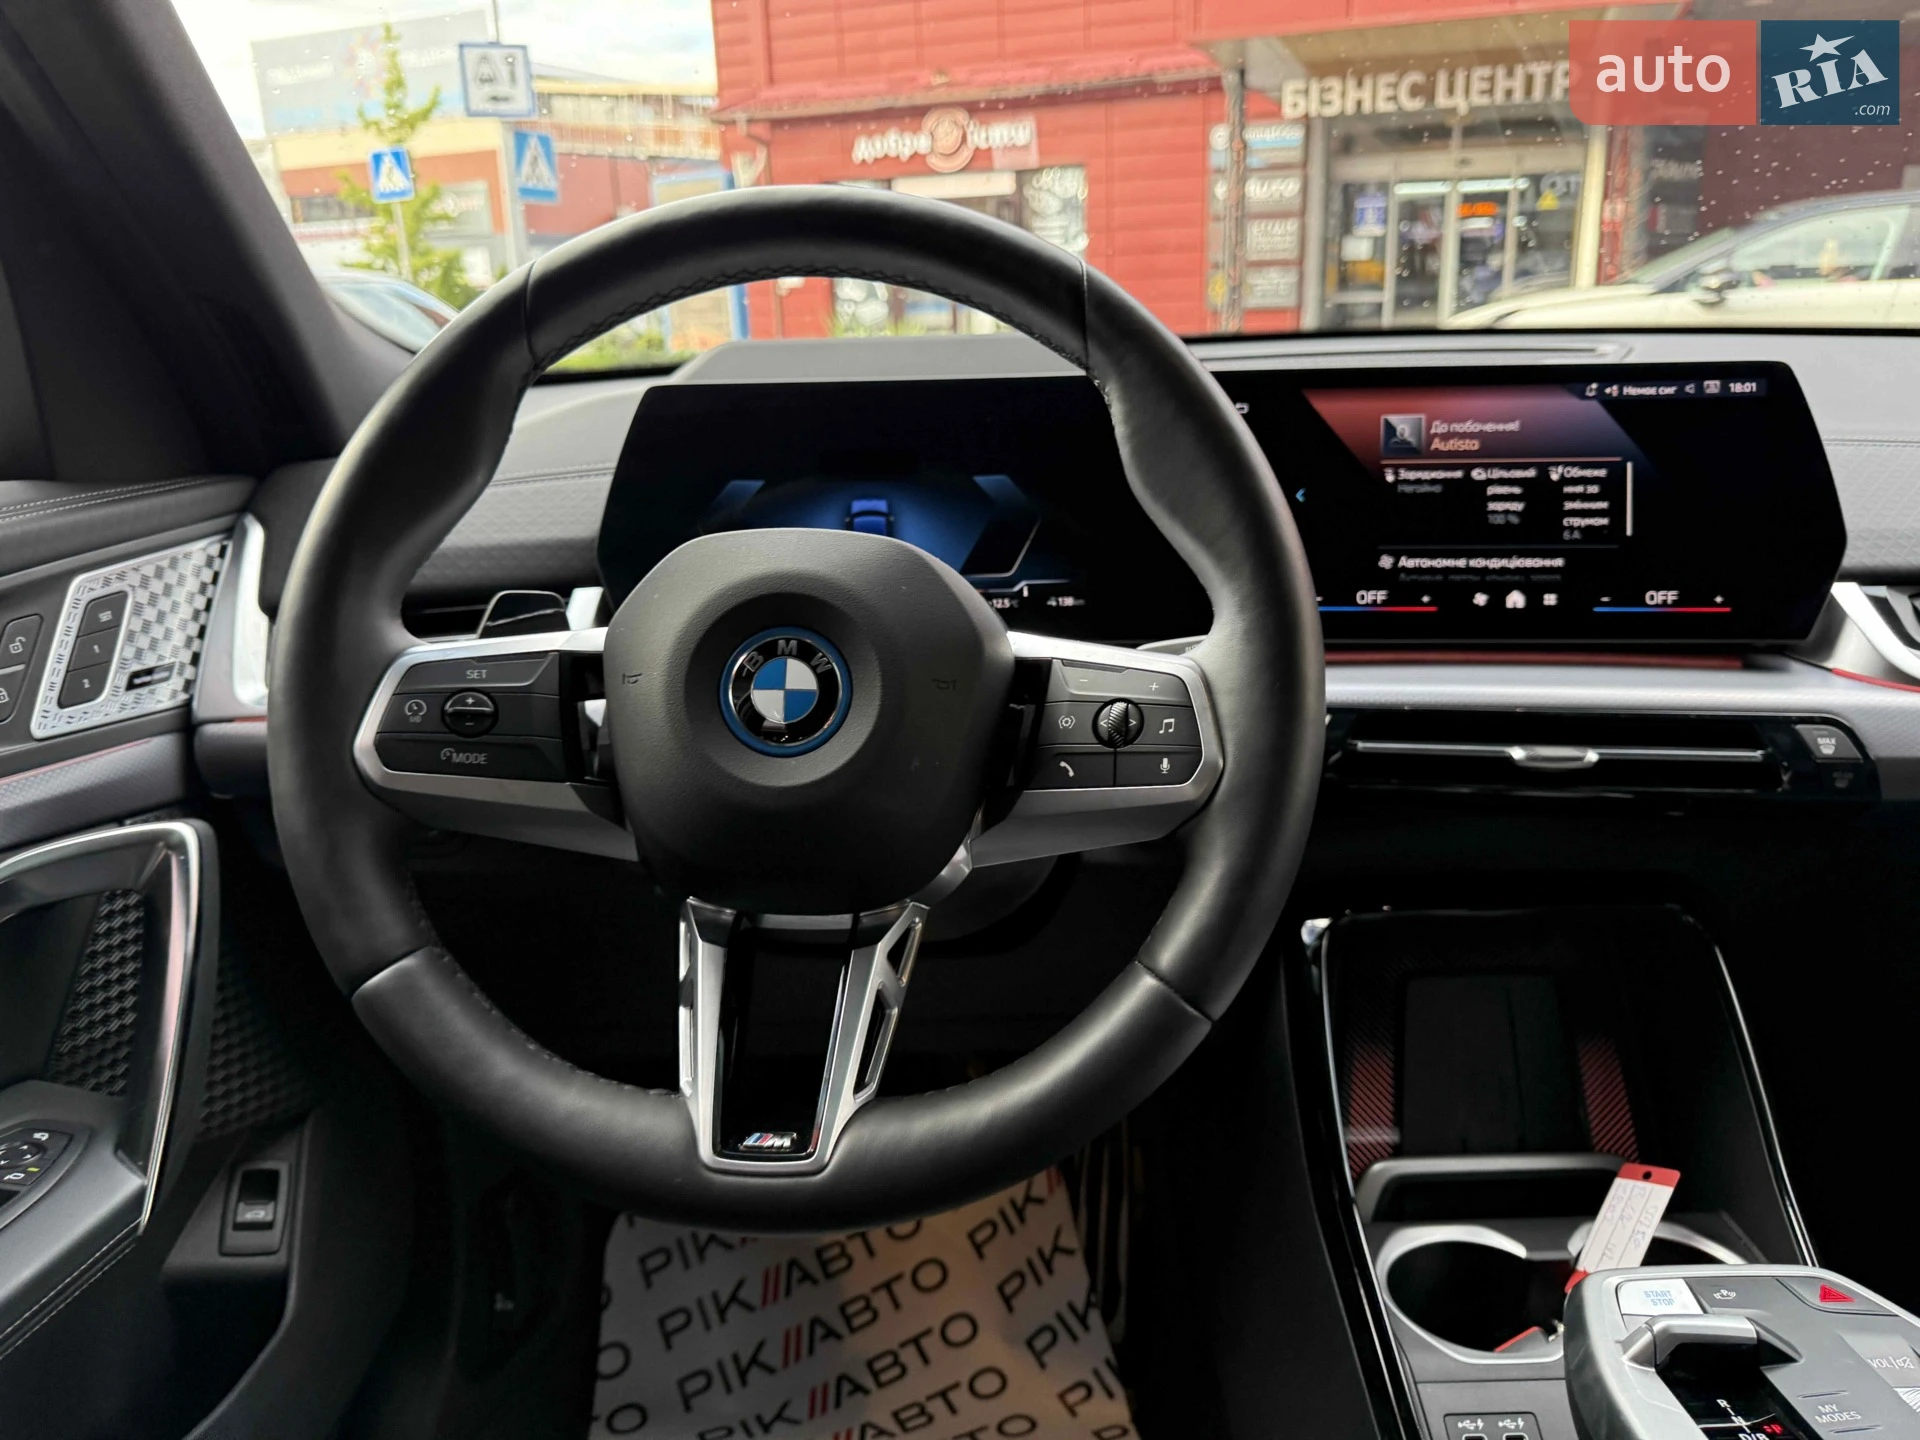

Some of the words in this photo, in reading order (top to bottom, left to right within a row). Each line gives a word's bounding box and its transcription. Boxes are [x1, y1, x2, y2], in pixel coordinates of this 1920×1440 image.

[1281, 70, 1427, 119] БІЗНЕС
[1729, 382, 1758, 394] 18:01
[1431, 420, 1448, 434] До
[1356, 590, 1388, 605] OFF
[1645, 590, 1679, 605] OFF
[742, 639, 832, 674] BMW
[466, 669, 487, 680] SET
[452, 753, 488, 764] MODE
[1644, 1290, 1672, 1299] START
[1650, 1298, 1675, 1306] STOP
[1867, 1357, 1892, 1369] VOL
[1818, 1403, 1837, 1414] MY
[1815, 1410, 1861, 1423] MODES
